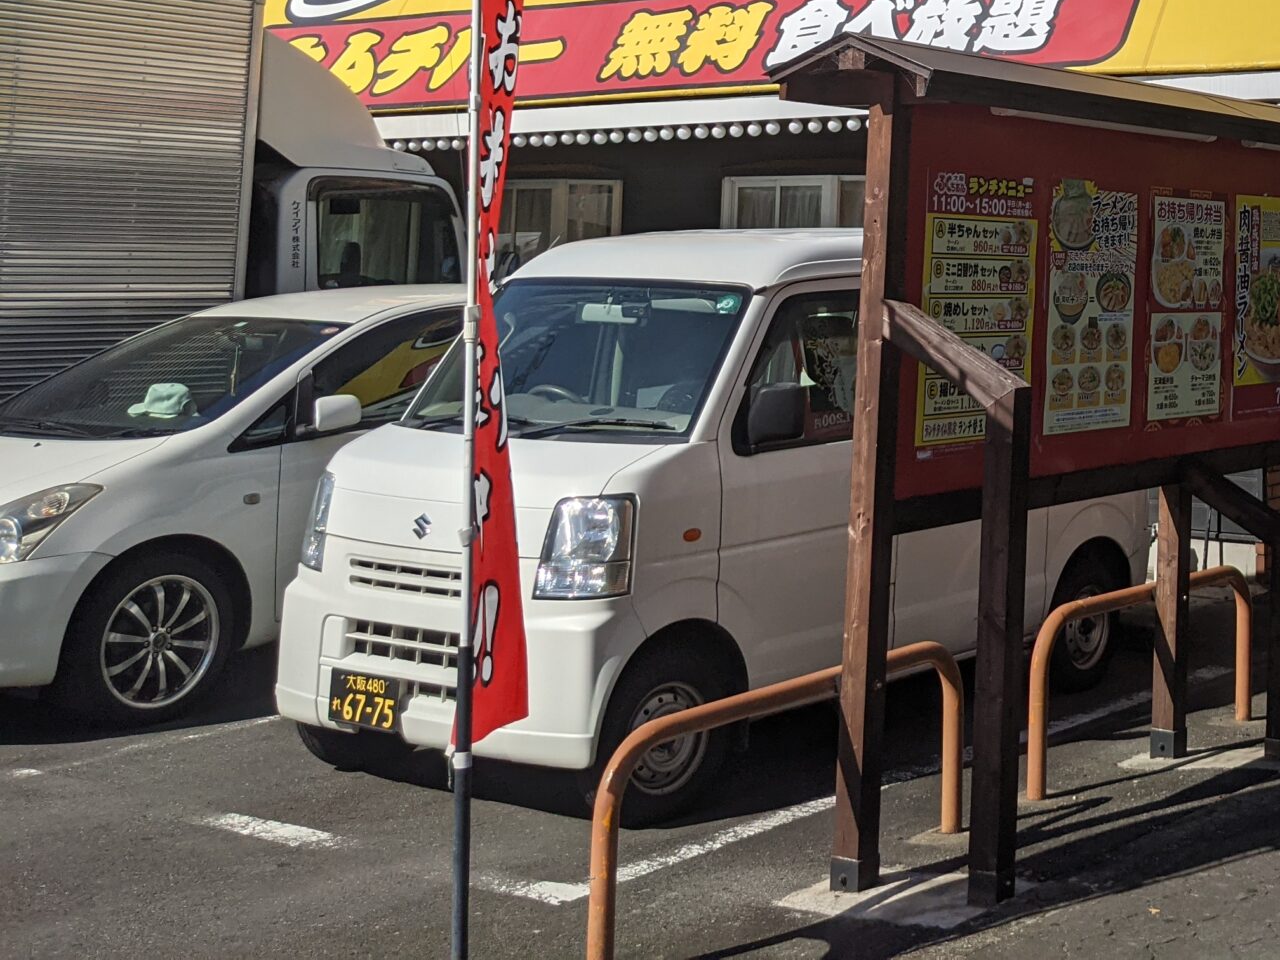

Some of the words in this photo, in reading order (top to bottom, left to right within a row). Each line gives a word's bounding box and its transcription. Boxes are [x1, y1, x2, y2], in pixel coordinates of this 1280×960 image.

[600, 0, 766, 80] 無料
[968, 176, 1034, 198] ランチメニュー
[1092, 214, 1135, 233] お持ち帰り
[1157, 202, 1223, 224] お持ち帰り弁当
[291, 200, 301, 268] ケイアイ株式会社
[1237, 205, 1250, 378] 肉醤油ラーメン
[343, 693, 395, 729] 67-75
